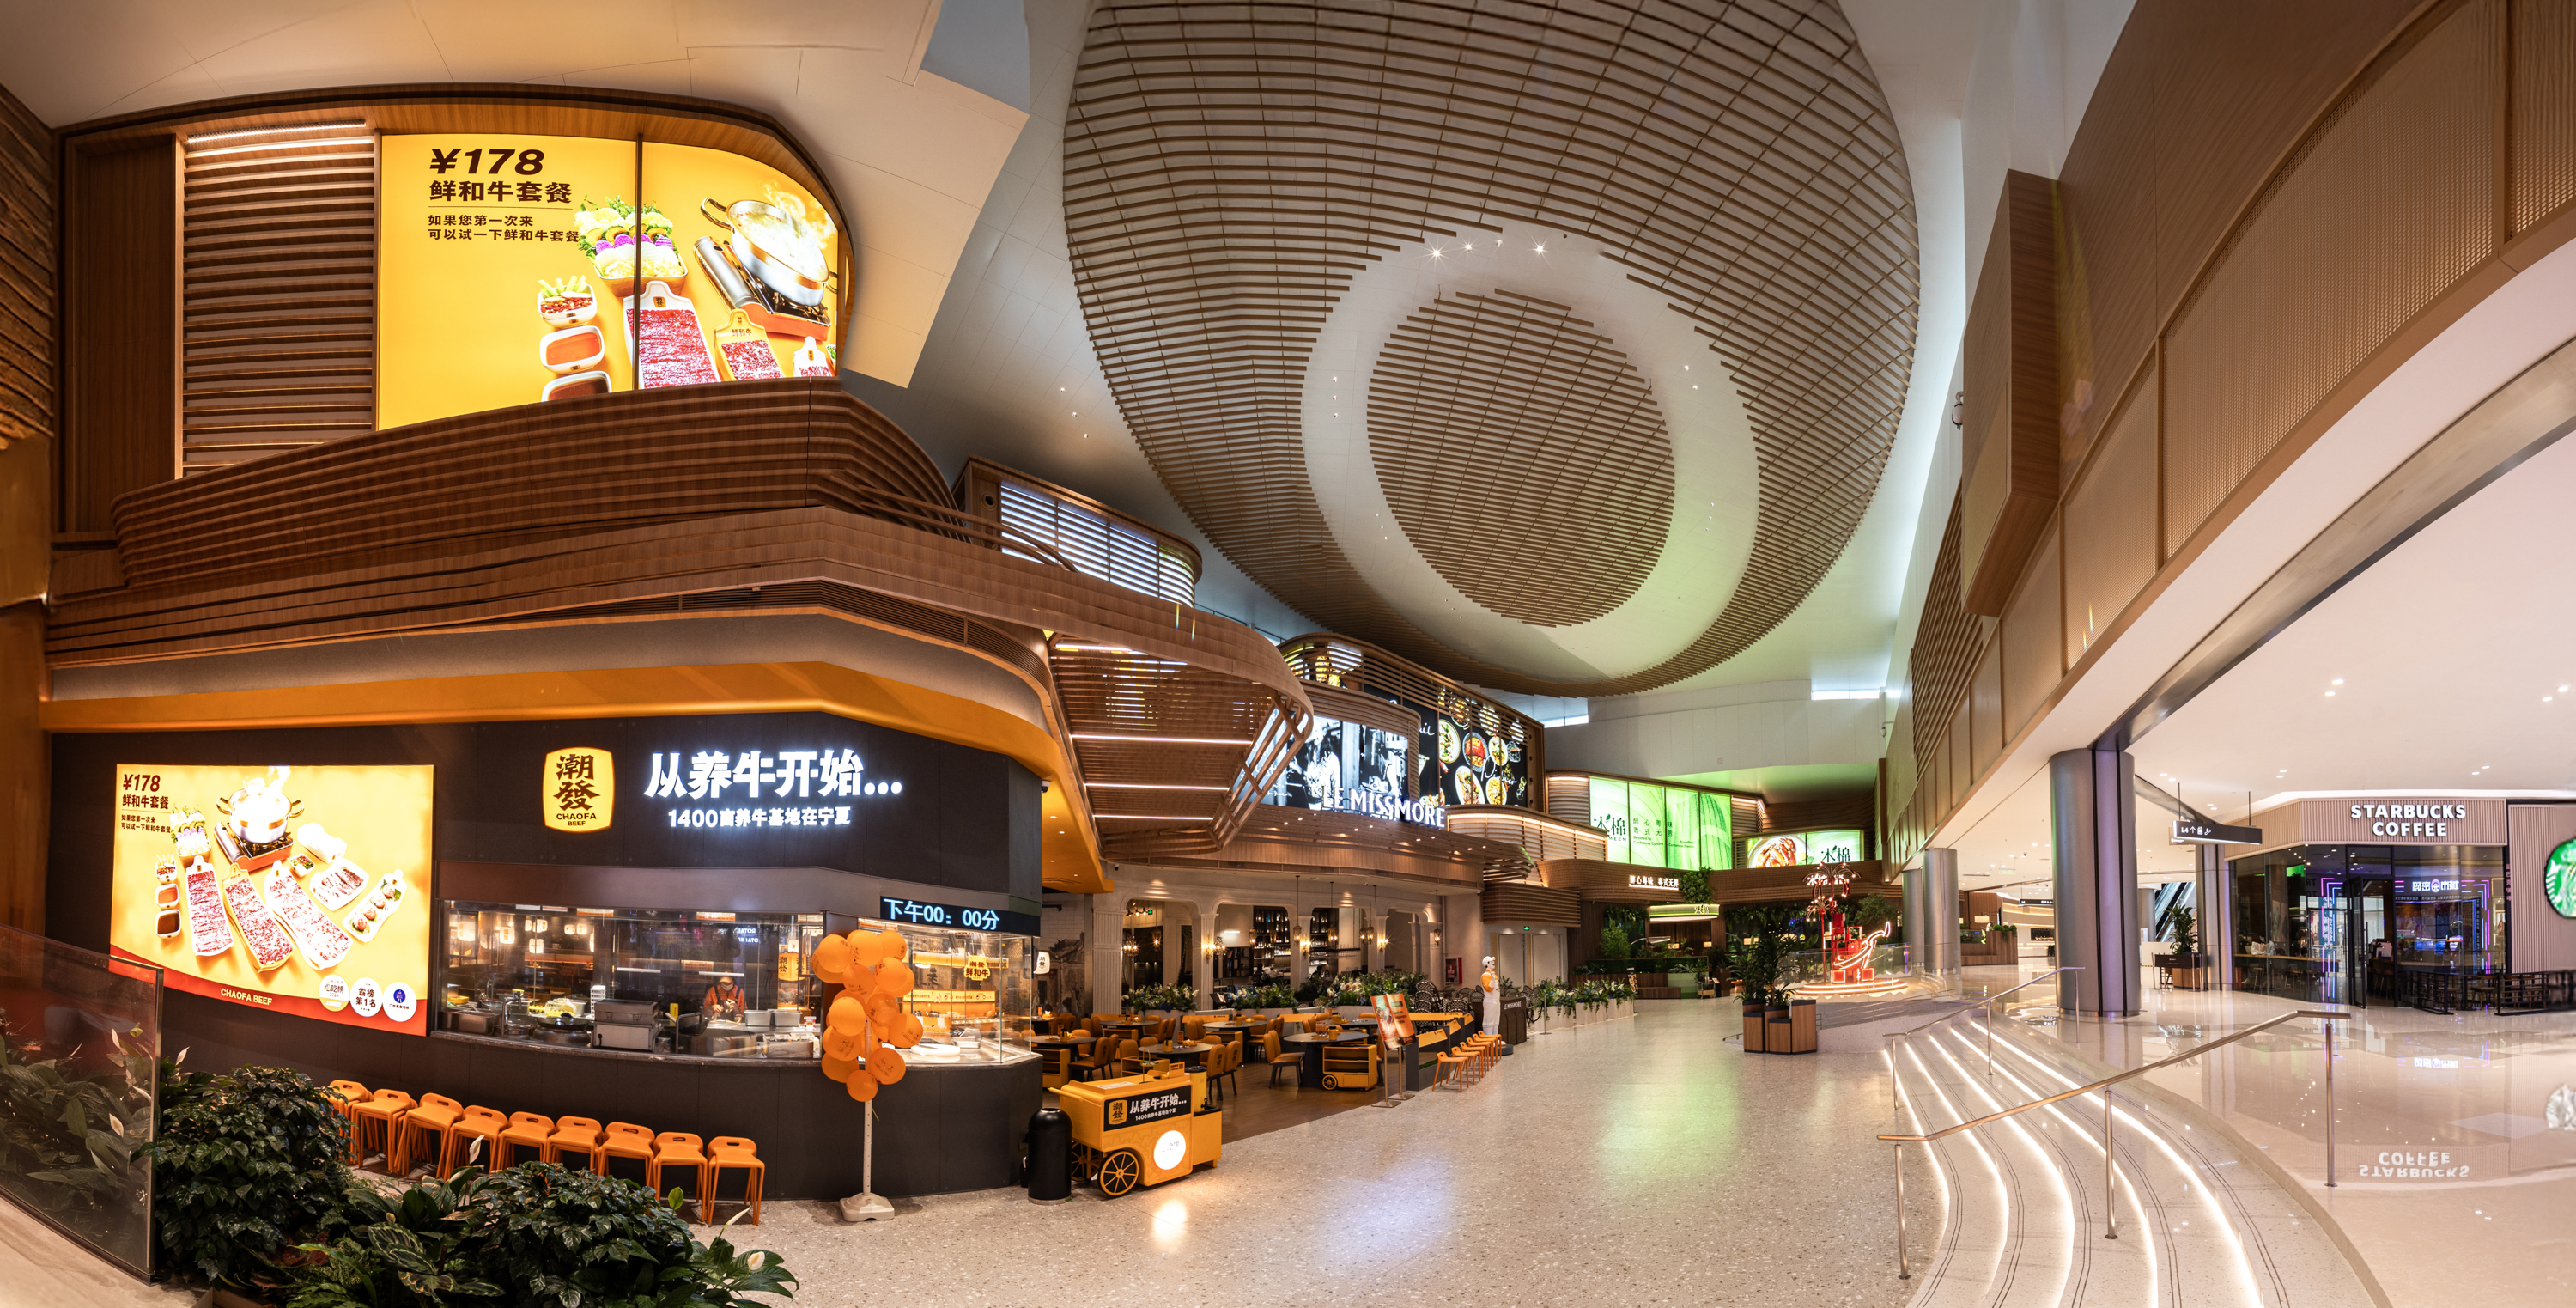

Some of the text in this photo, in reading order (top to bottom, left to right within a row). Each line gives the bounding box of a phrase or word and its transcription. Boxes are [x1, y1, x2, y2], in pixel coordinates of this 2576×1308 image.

[429, 148, 544, 176] ¥178
[429, 179, 572, 204] 鲜和牛套餐
[428, 214, 533, 227] 如果您第一次来
[428, 228, 580, 243] 可以试一下鲜和牛套餐
[123, 774, 161, 792] ¥178
[122, 794, 169, 810] 鲜和牛套餐
[1321, 785, 1446, 829] LE MISSMORE
[121, 814, 155, 823] 如果您第一次来
[667, 806, 851, 829] 1400亩养牛基地在宁夏
[2350, 804, 2466, 819] STARBUCKS
[2372, 821, 2447, 837] COFFEE
[966, 968, 989, 977] 鲜和牛
[221, 988, 272, 1006] CHAOFA BEEF
[355, 996, 376, 1008] 第1名
